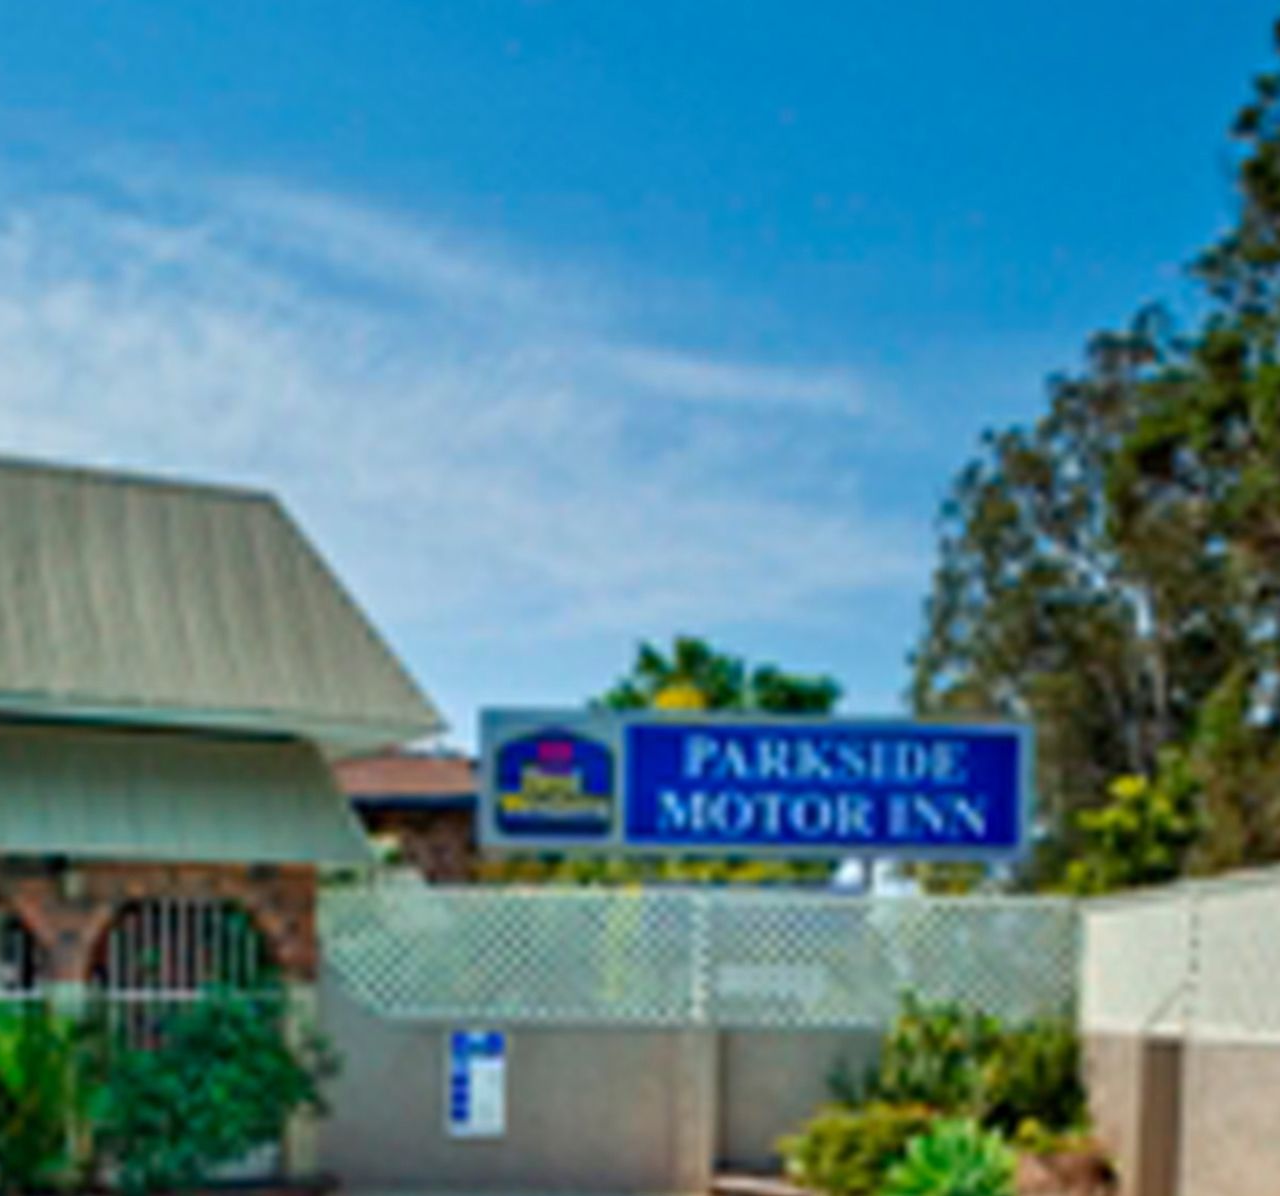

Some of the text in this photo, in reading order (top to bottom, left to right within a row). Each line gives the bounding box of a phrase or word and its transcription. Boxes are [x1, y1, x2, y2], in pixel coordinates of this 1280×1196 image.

[682, 735, 968, 785] PARKSIDE
[658, 790, 873, 838] MOTOR
[887, 792, 987, 837] INN
